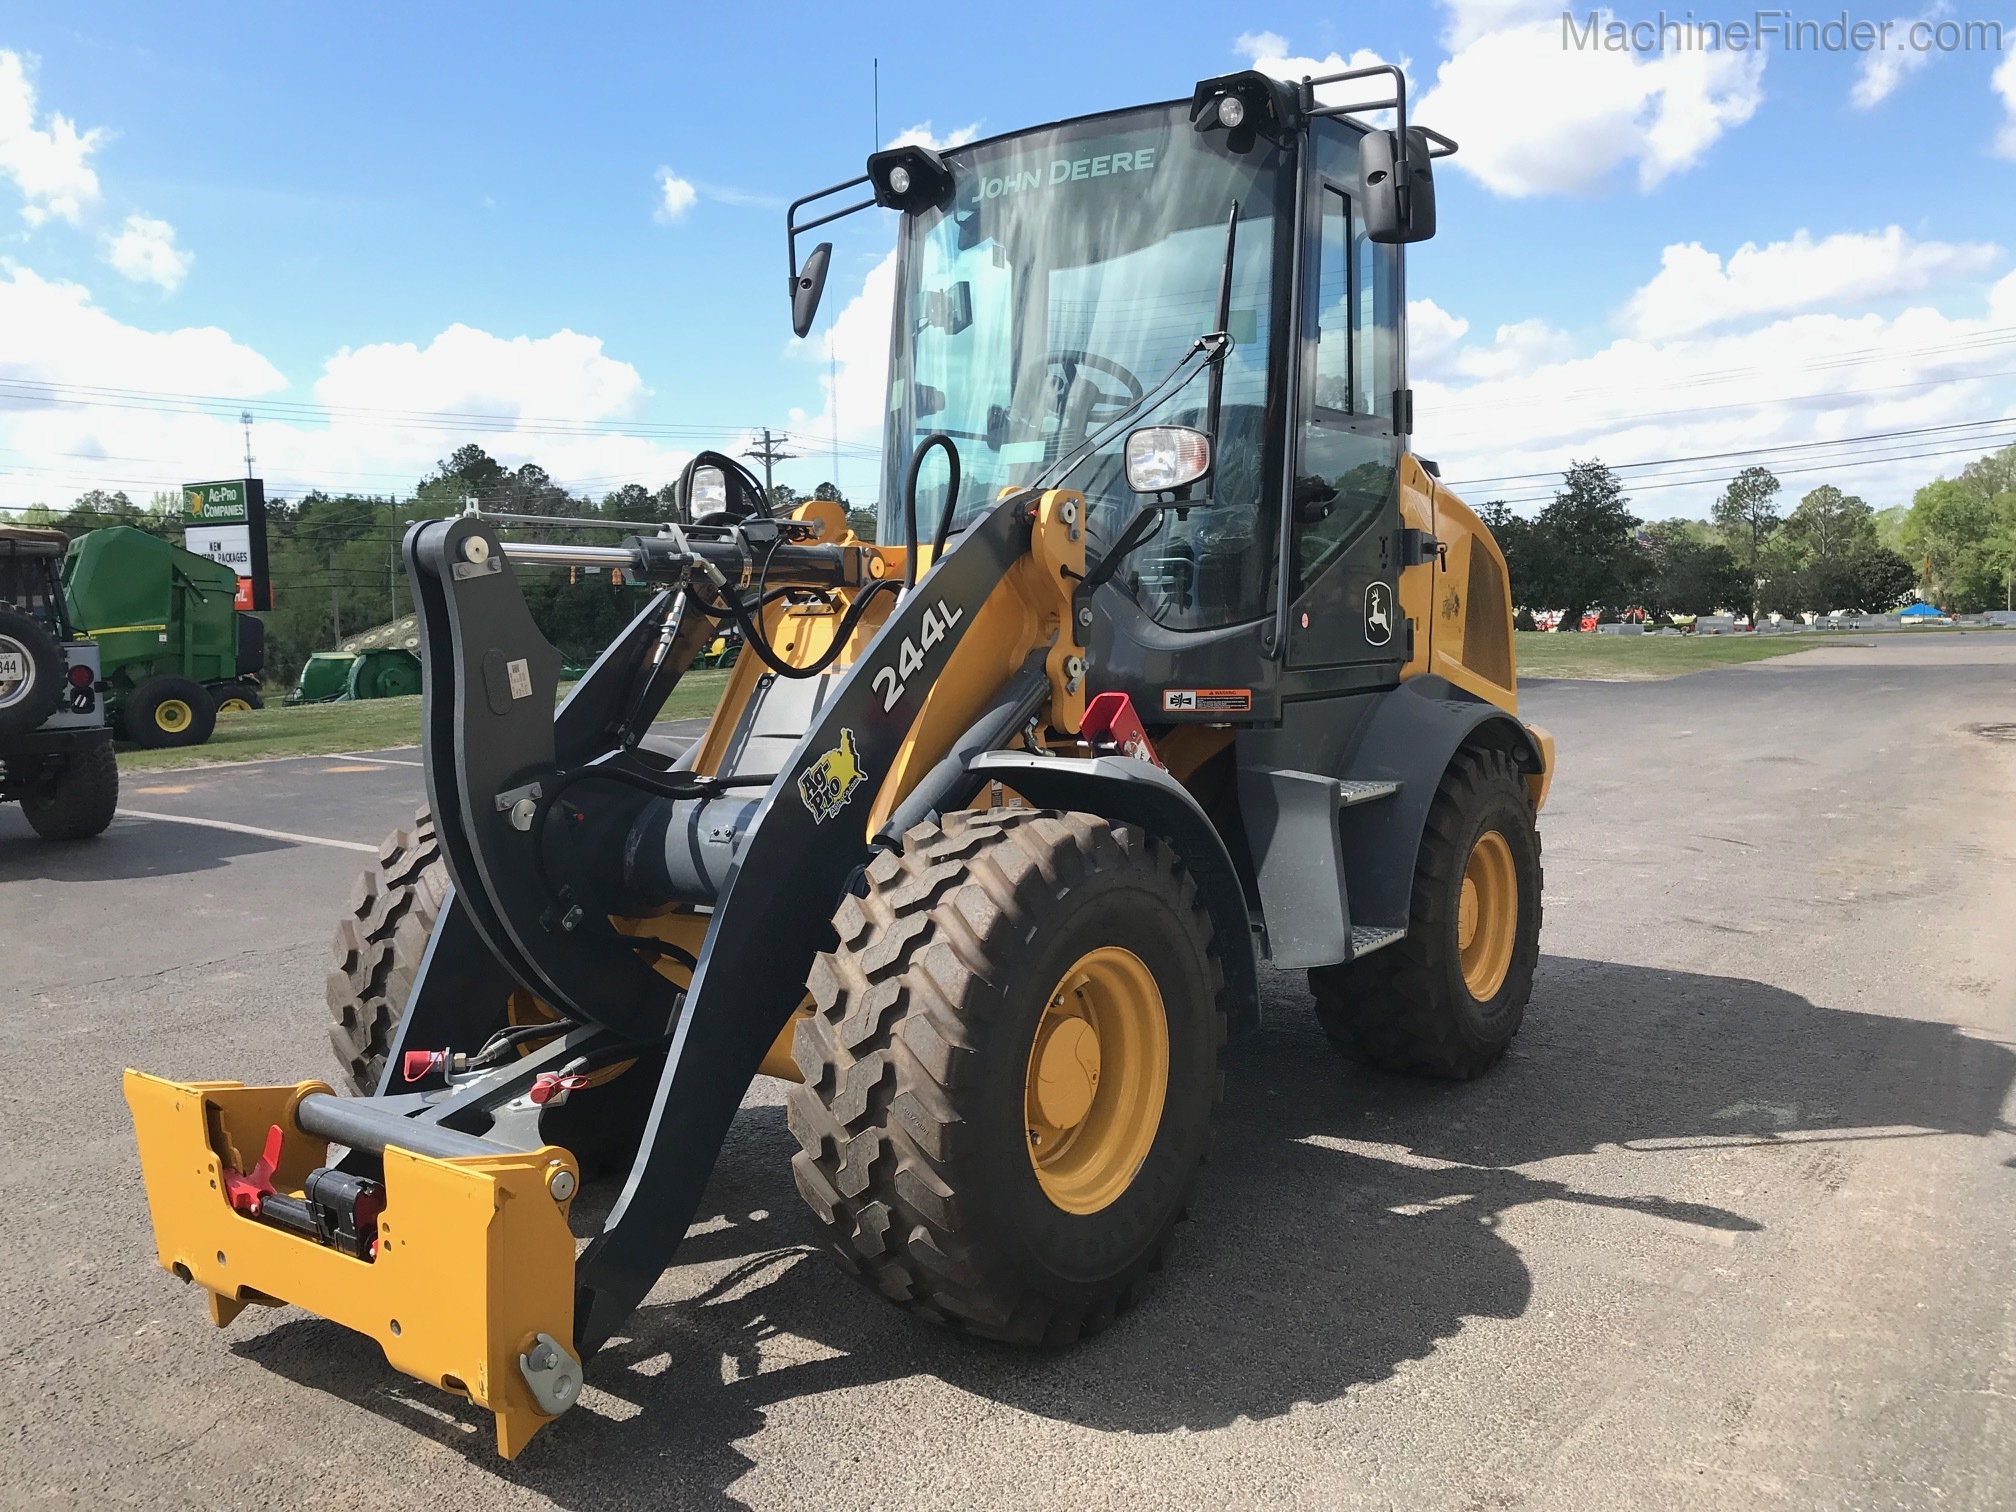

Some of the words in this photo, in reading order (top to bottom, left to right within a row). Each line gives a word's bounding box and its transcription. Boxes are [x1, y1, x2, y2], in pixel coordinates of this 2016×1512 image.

[971, 168, 1042, 204] JOHN
[1048, 147, 1156, 186] DEERE
[203, 503, 244, 518] COMPANIES
[209, 541, 222, 551] NEW
[218, 552, 248, 563] PACKAGES
[871, 599, 964, 713] 244L
